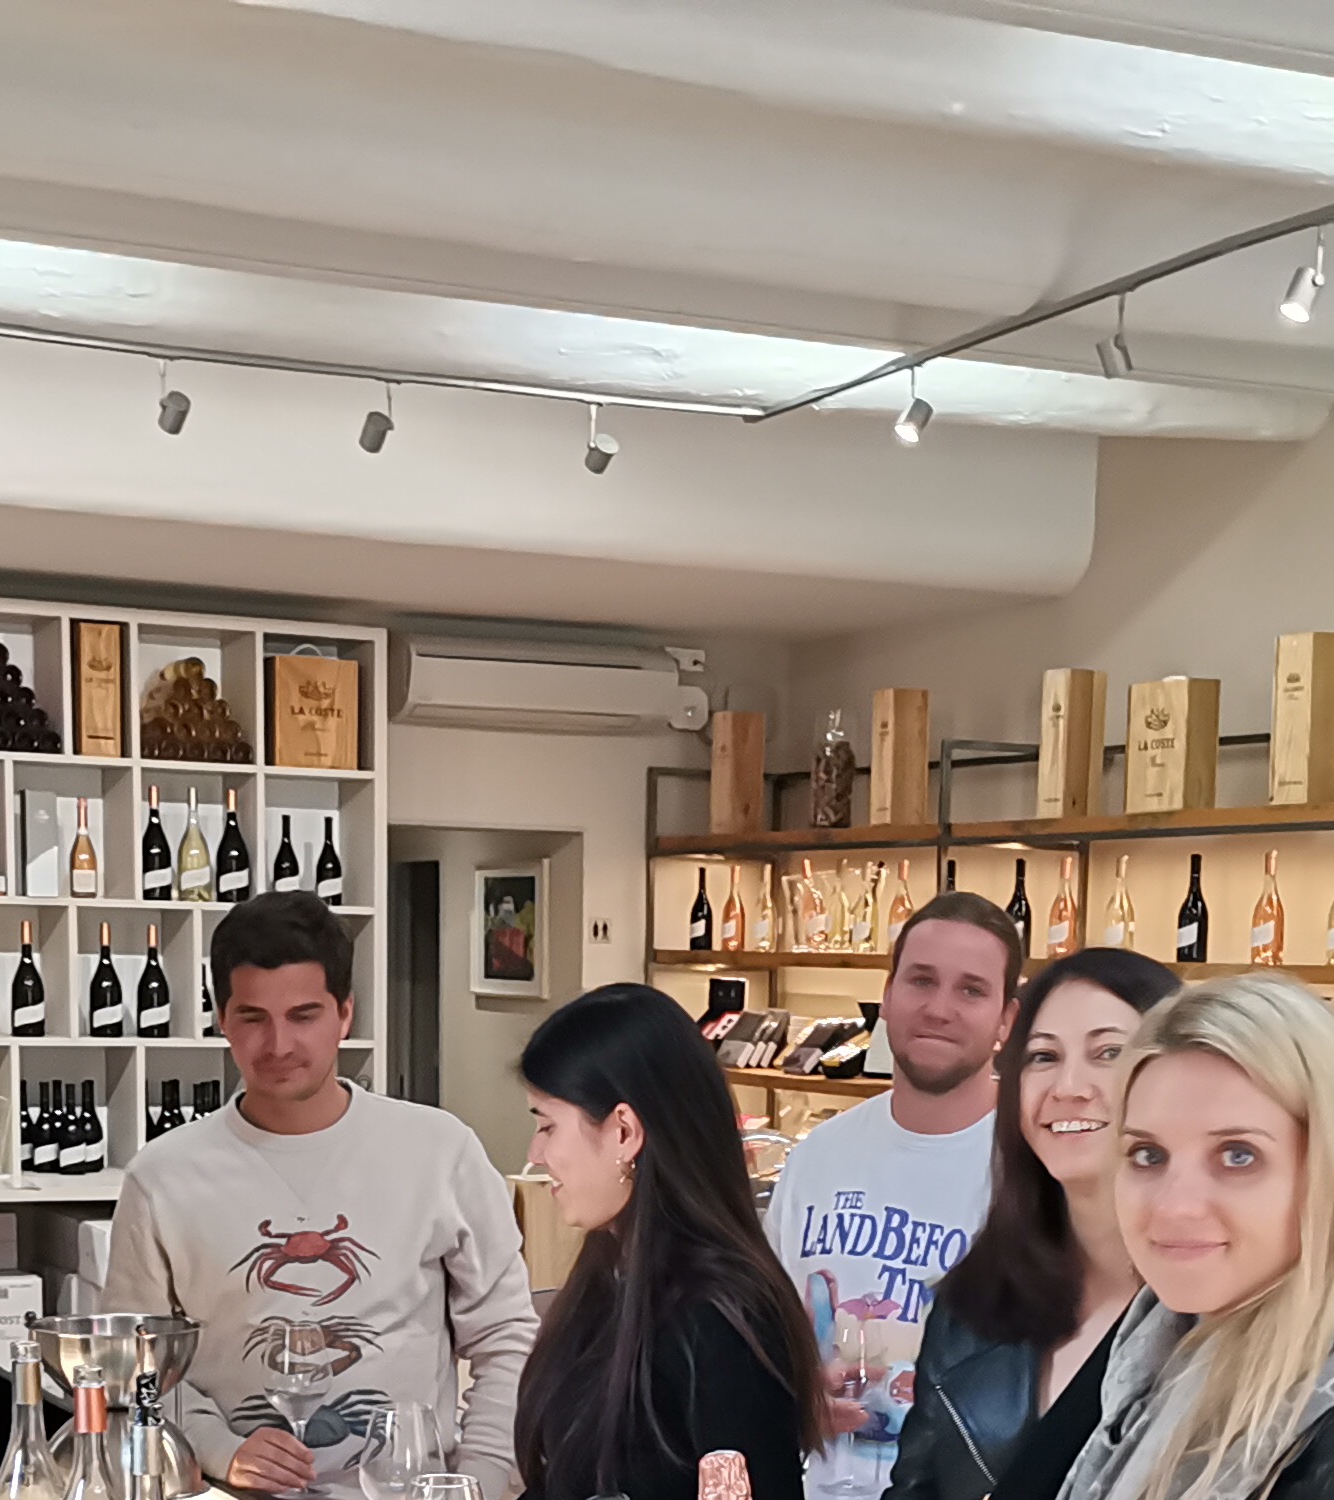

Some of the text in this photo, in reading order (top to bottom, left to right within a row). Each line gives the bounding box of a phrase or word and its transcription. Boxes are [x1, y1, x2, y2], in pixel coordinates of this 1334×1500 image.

[833, 1190, 866, 1211] THE
[800, 1205, 967, 1272] LAND BEFO
